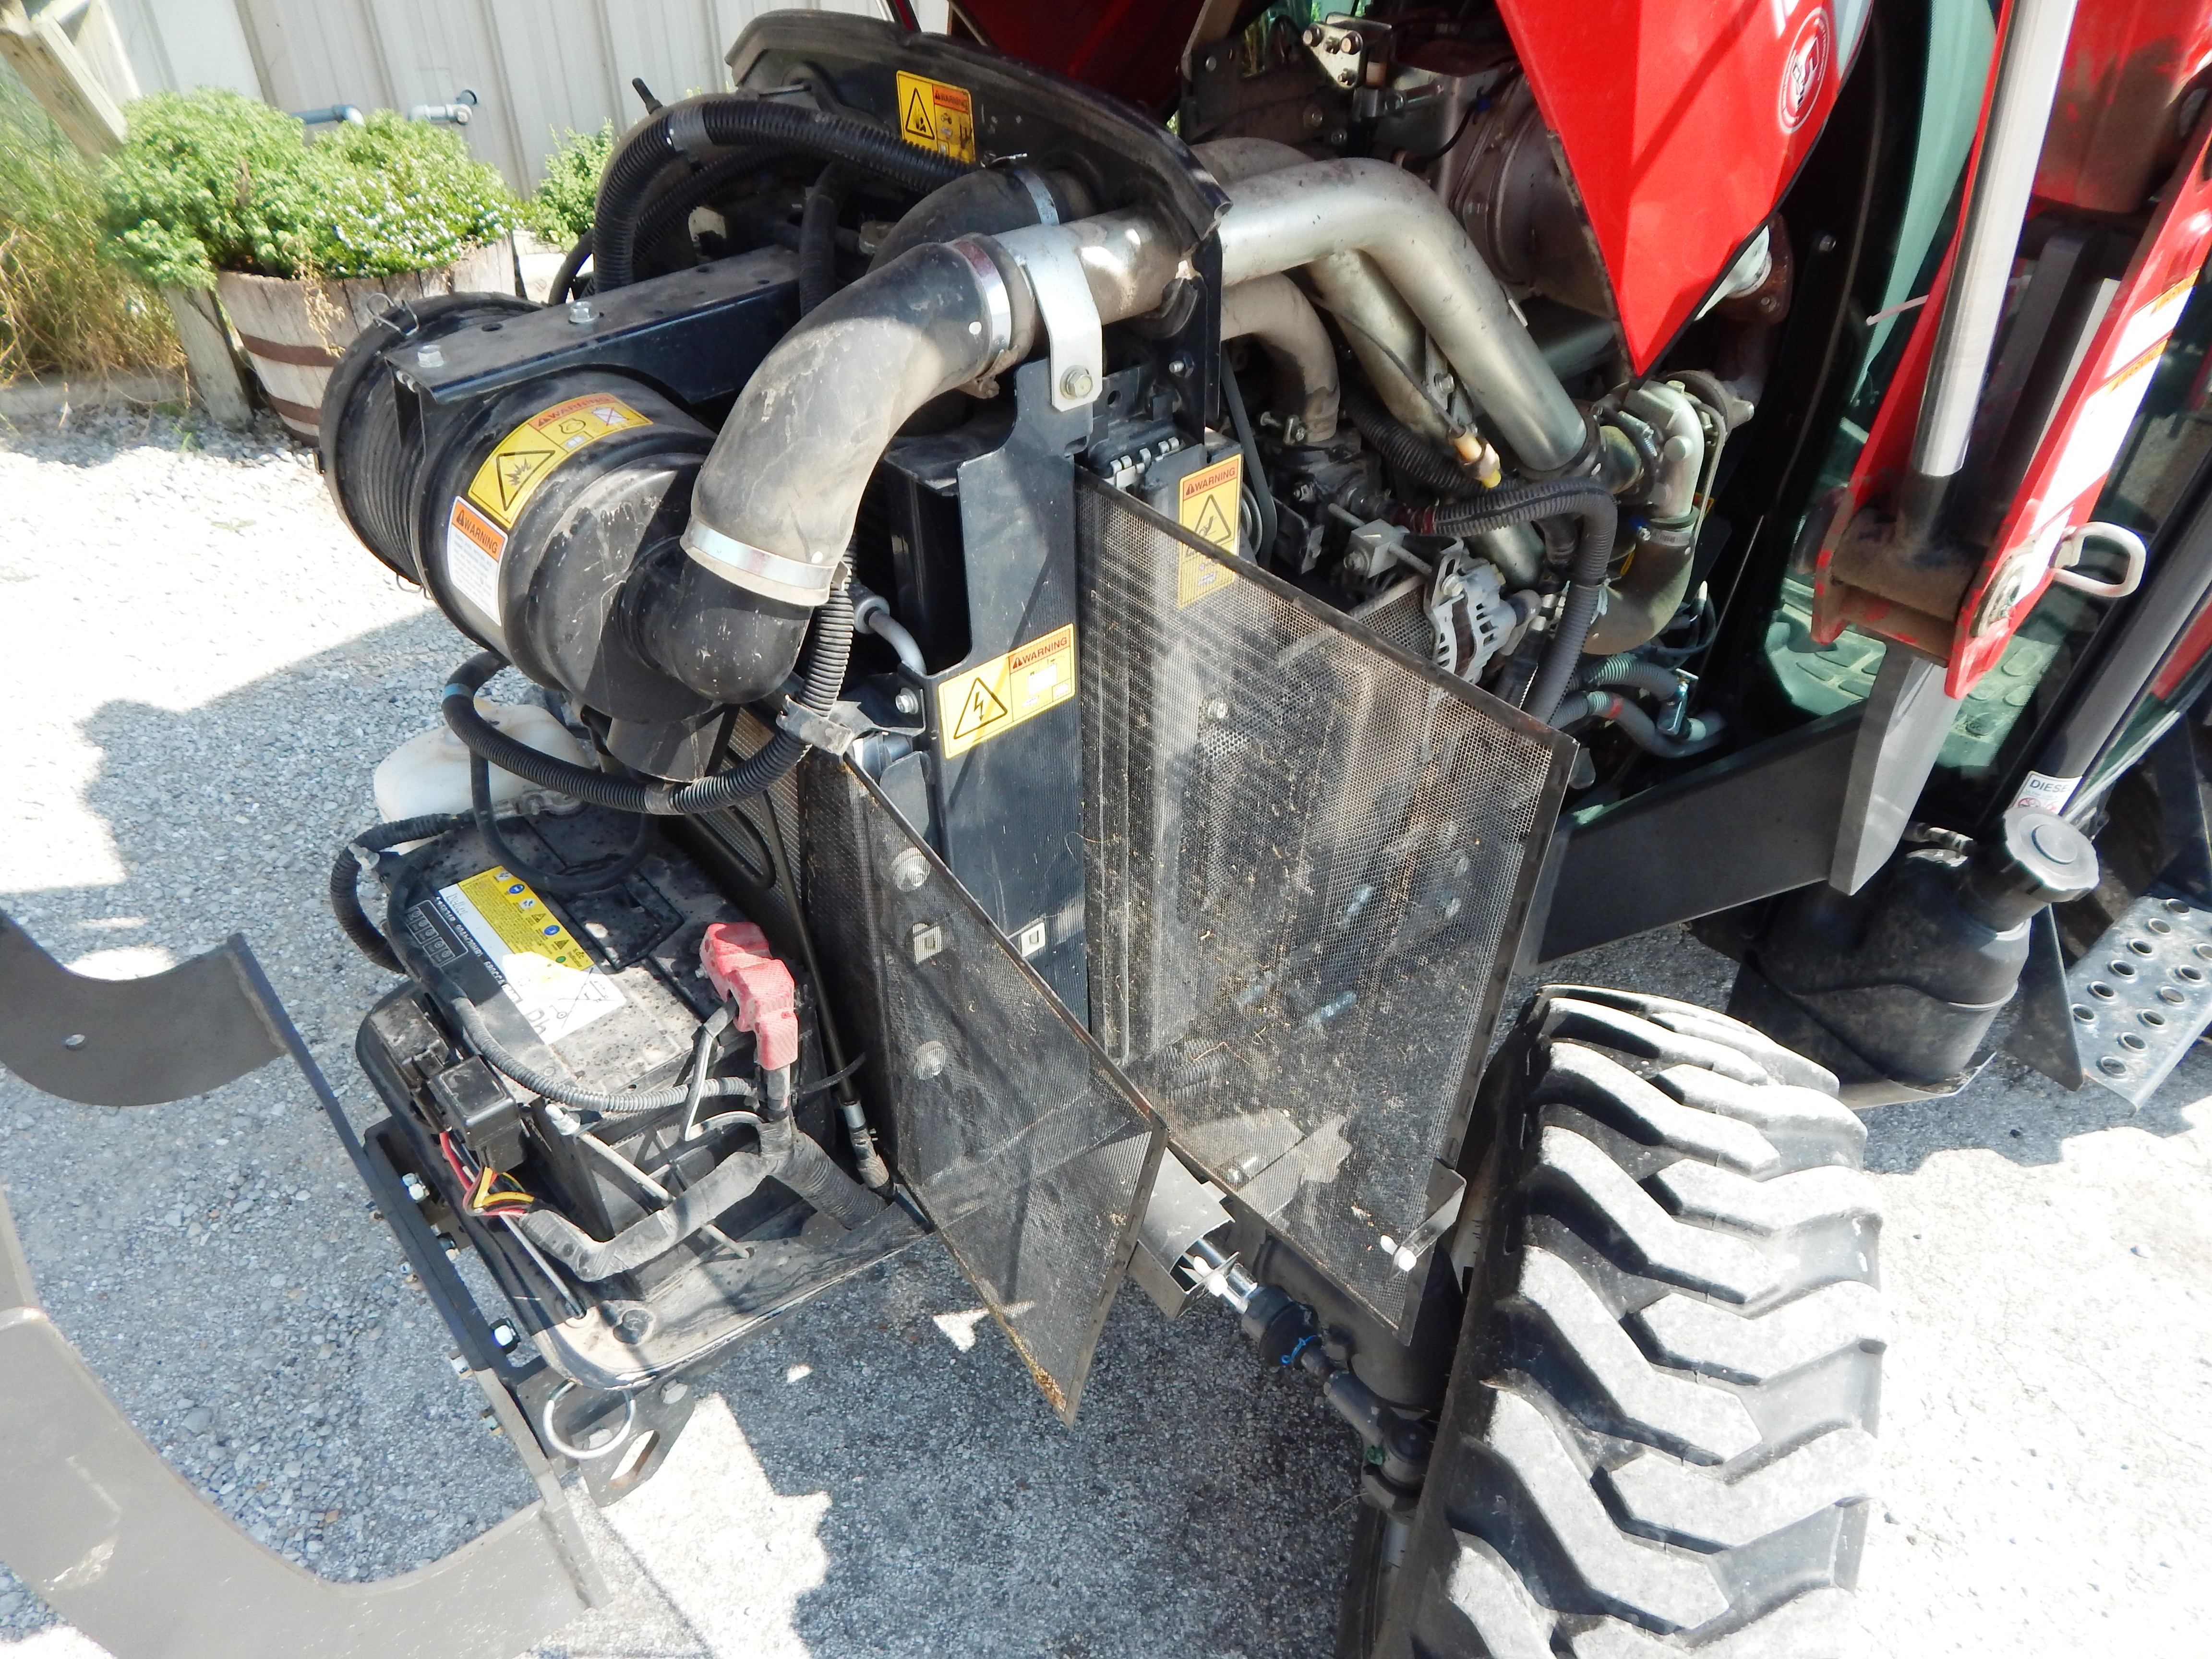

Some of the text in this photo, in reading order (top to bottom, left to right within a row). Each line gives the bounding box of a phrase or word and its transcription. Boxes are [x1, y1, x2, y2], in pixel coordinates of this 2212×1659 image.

[940, 93, 968, 110] WARNING
[548, 397, 610, 419] WARNING
[1194, 467, 1235, 492] WARNING
[464, 517, 498, 554] WARNING
[1022, 637, 1067, 665] WARNING
[2030, 779, 2071, 793] DIESE
